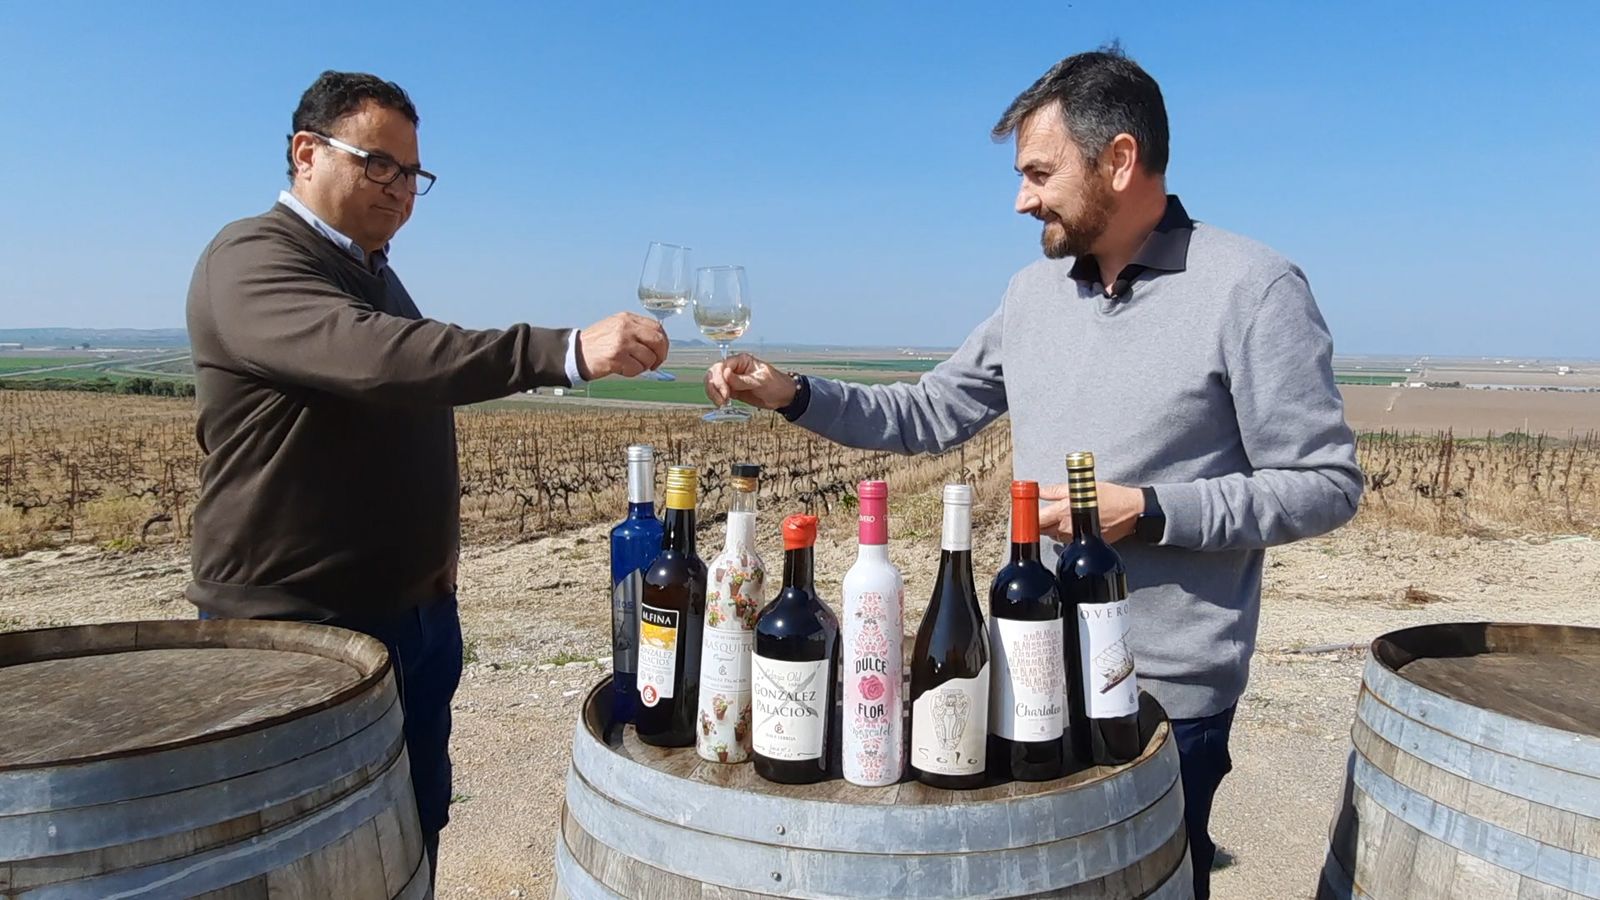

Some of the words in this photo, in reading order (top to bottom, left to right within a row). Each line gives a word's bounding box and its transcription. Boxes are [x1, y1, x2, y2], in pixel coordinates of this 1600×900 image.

[1080, 603, 1129, 620] OVERO
[855, 657, 888, 676] DULCE
[756, 699, 812, 718] PALACIOS
[858, 702, 885, 719] FLOR
[917, 747, 978, 766] Solo
